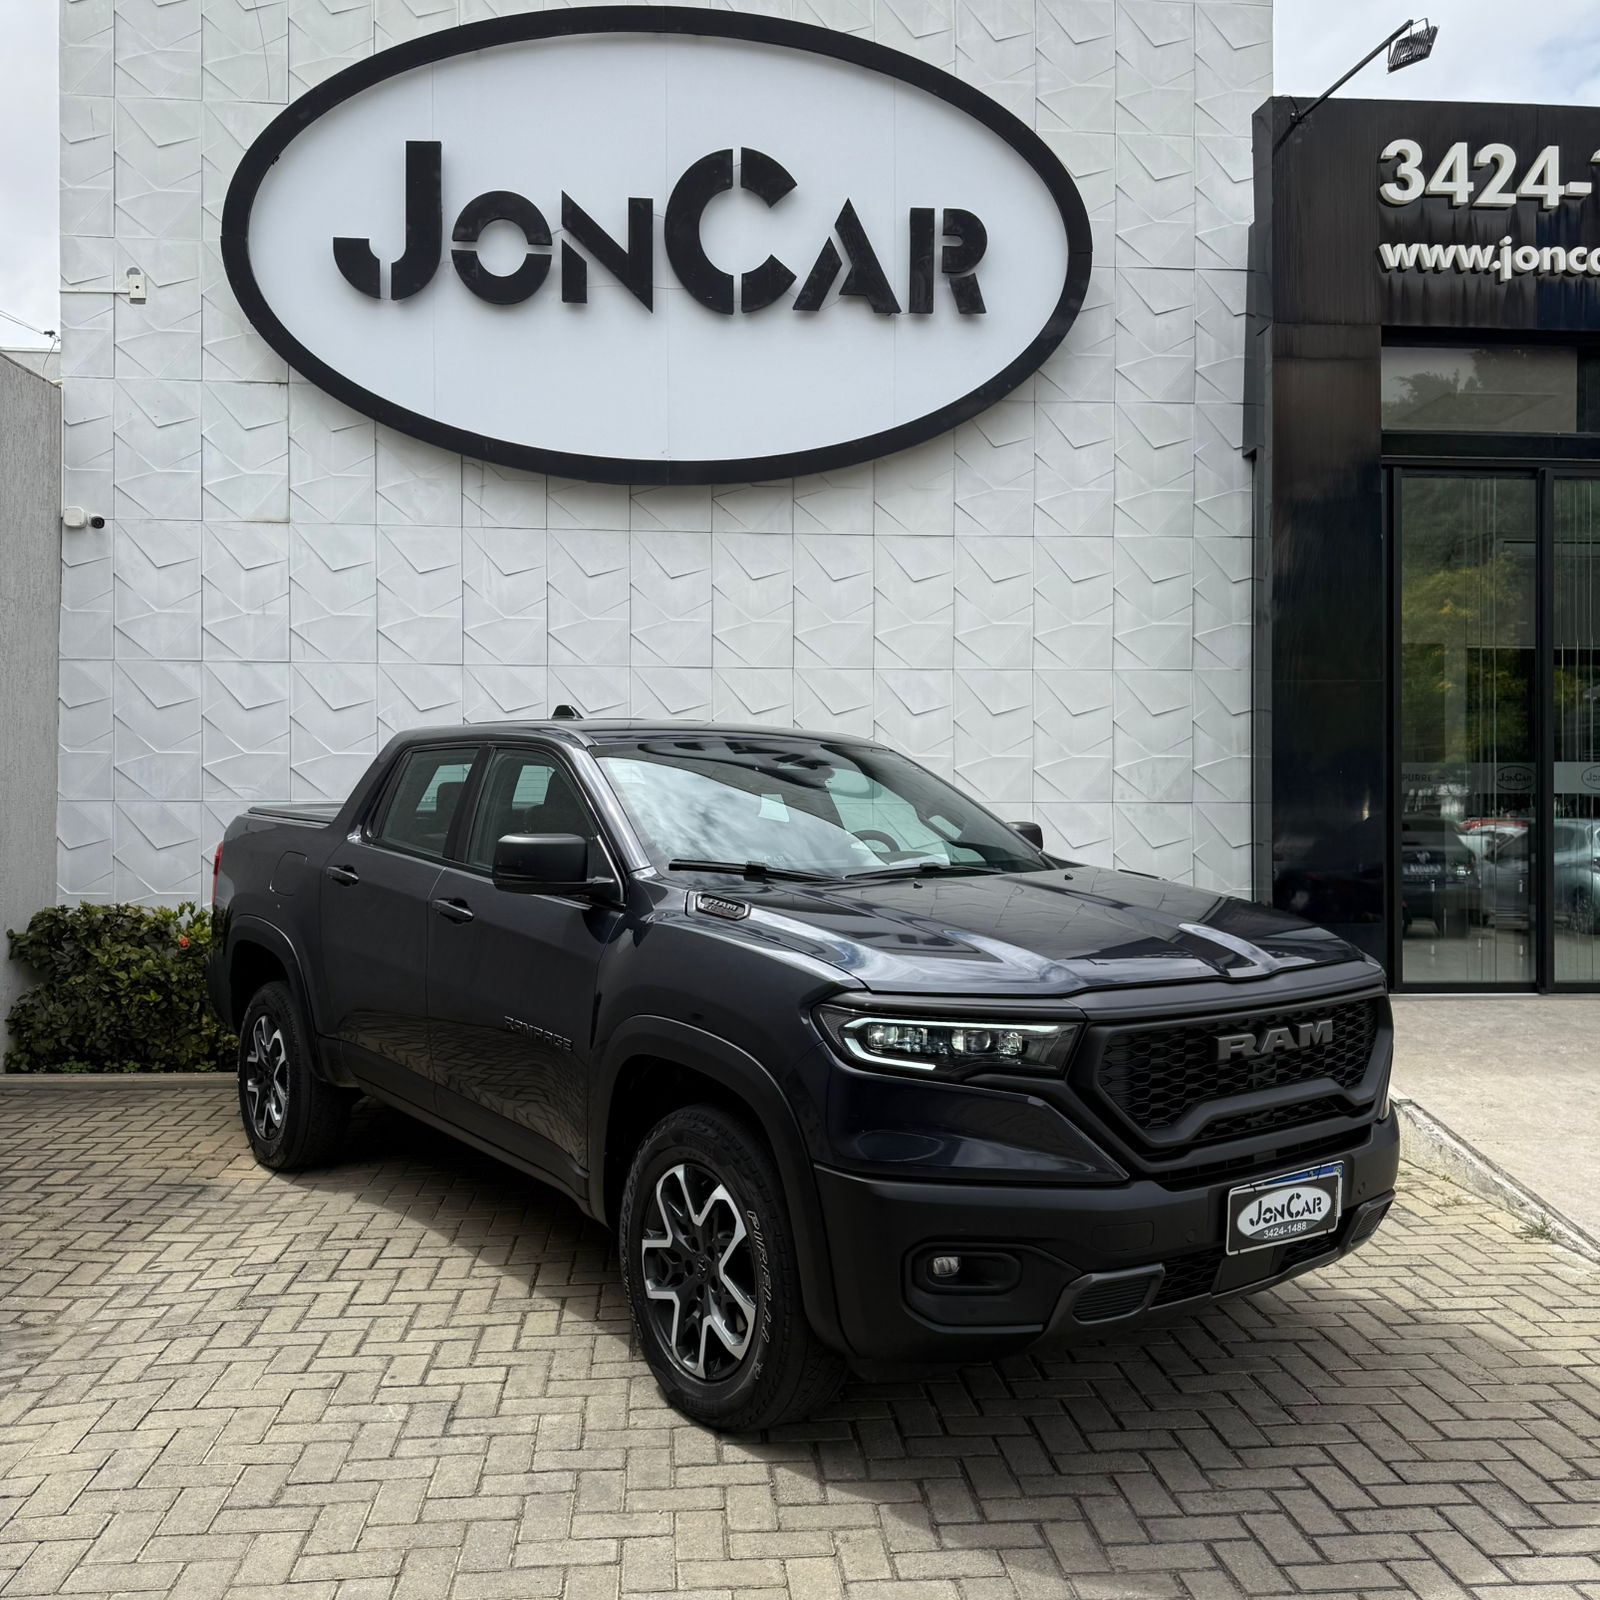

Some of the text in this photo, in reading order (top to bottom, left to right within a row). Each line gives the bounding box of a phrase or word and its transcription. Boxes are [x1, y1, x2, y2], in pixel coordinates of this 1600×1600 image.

[1379, 138, 1600, 209] 3424-
[504, 1015, 573, 1051] RAMPAGE
[1216, 1019, 1333, 1060] RAM
[1263, 1221, 1307, 1239] 3424-1488
